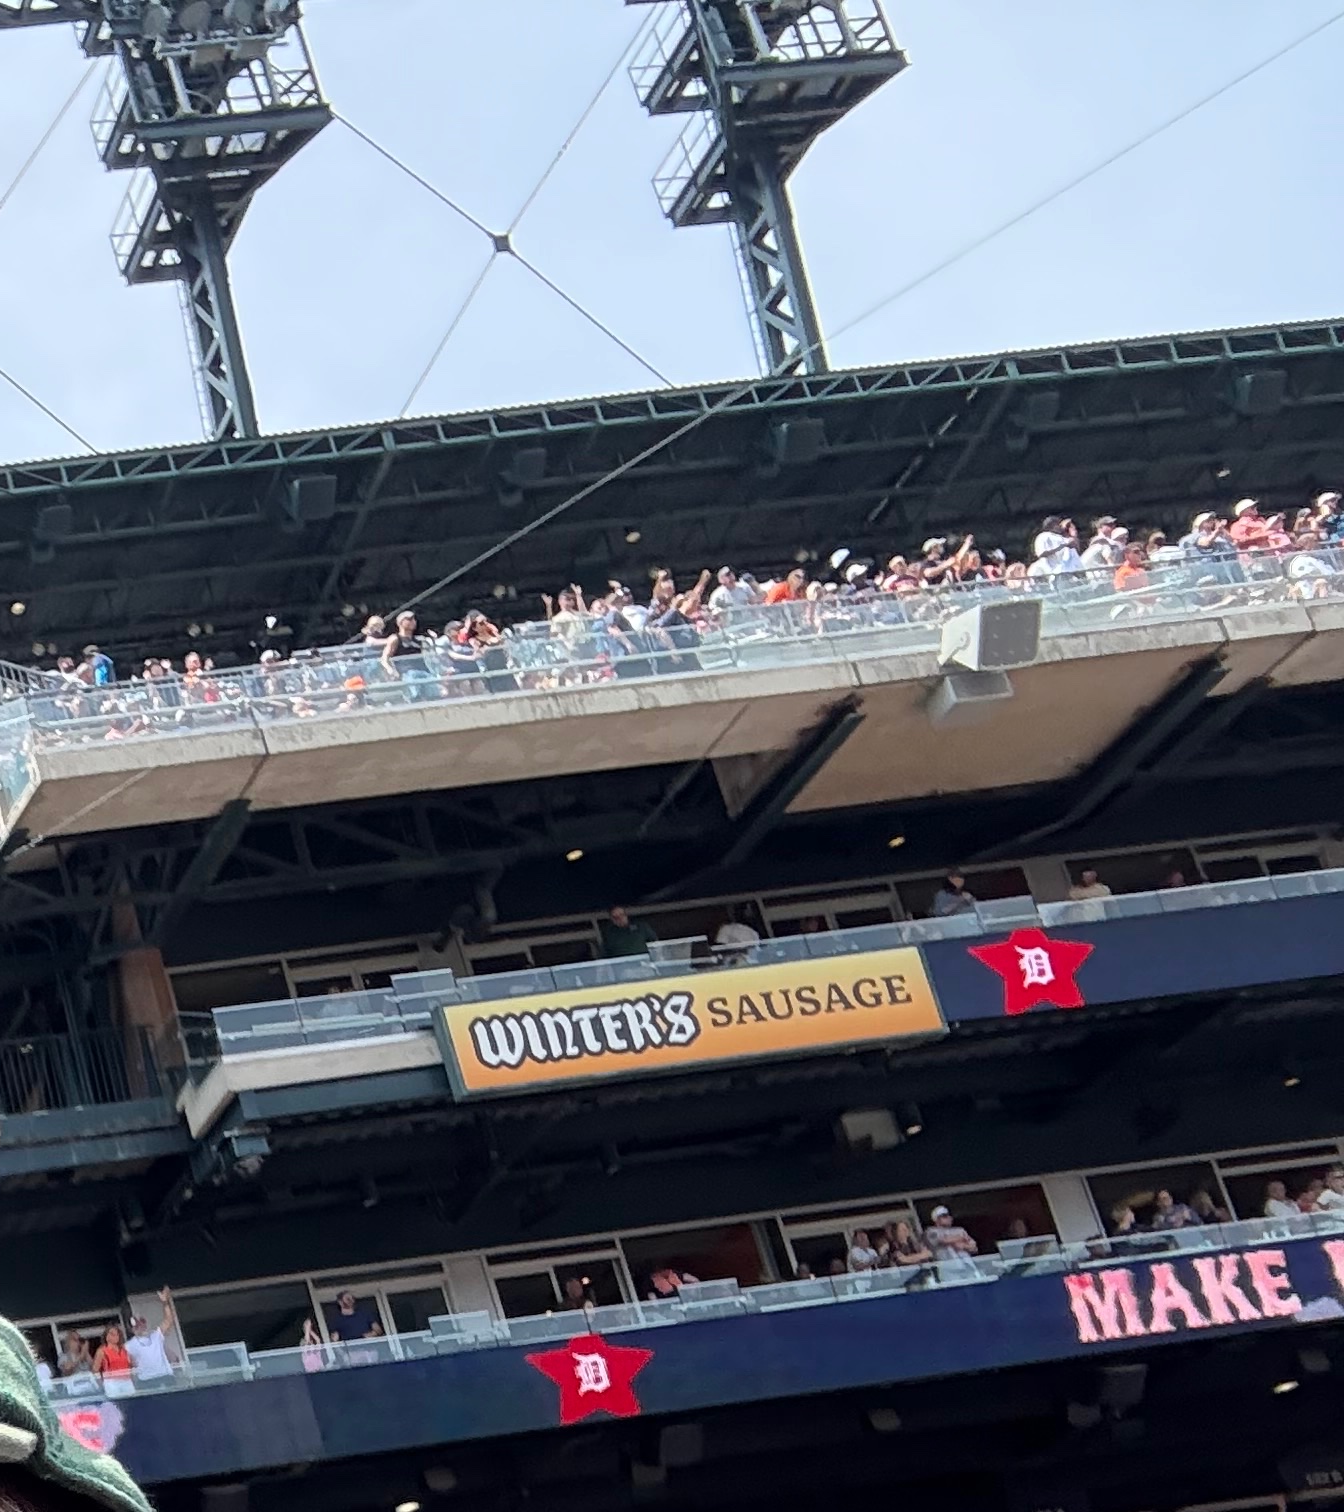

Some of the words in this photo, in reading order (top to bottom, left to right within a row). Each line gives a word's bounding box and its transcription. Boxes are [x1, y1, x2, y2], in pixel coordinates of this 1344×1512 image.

[471, 992, 699, 1068] WINTER'S
[708, 975, 913, 1027] SAUSAGE
[1064, 1250, 1302, 1343] MAKE
